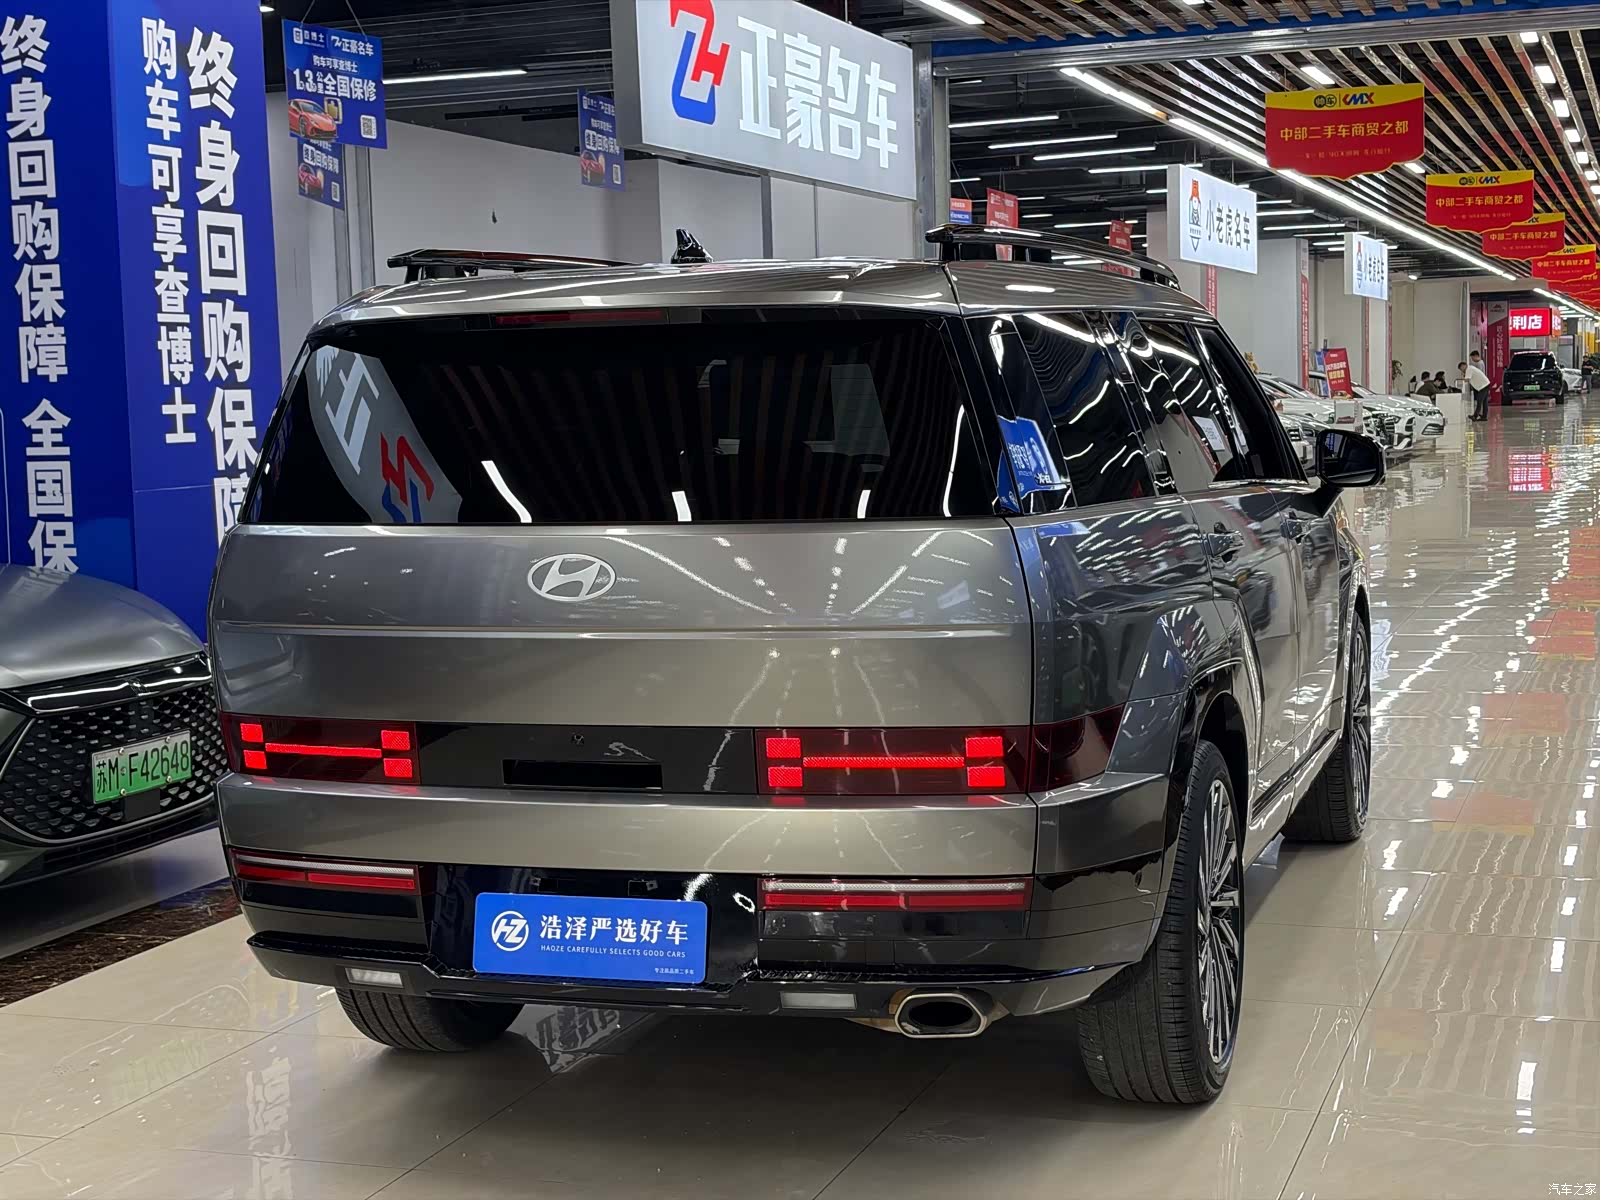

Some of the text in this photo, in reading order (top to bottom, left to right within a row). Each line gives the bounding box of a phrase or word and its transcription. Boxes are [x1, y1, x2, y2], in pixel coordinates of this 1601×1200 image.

[737, 15, 899, 169] 正豪名车
[1280, 120, 1409, 142] 中部二手车商贸之都
[1, 15, 69, 383] 终身回购保障
[1435, 194, 1524, 208] 中部二手车商贸之都
[142, 17, 196, 443] 购车可享查博士
[1205, 199, 1251, 252] 小老虎名车
[540, 914, 689, 945] 浩泽严选好车
[541, 944, 686, 958] HAOZE CAREFULLY SELECTS GOOD CARS
